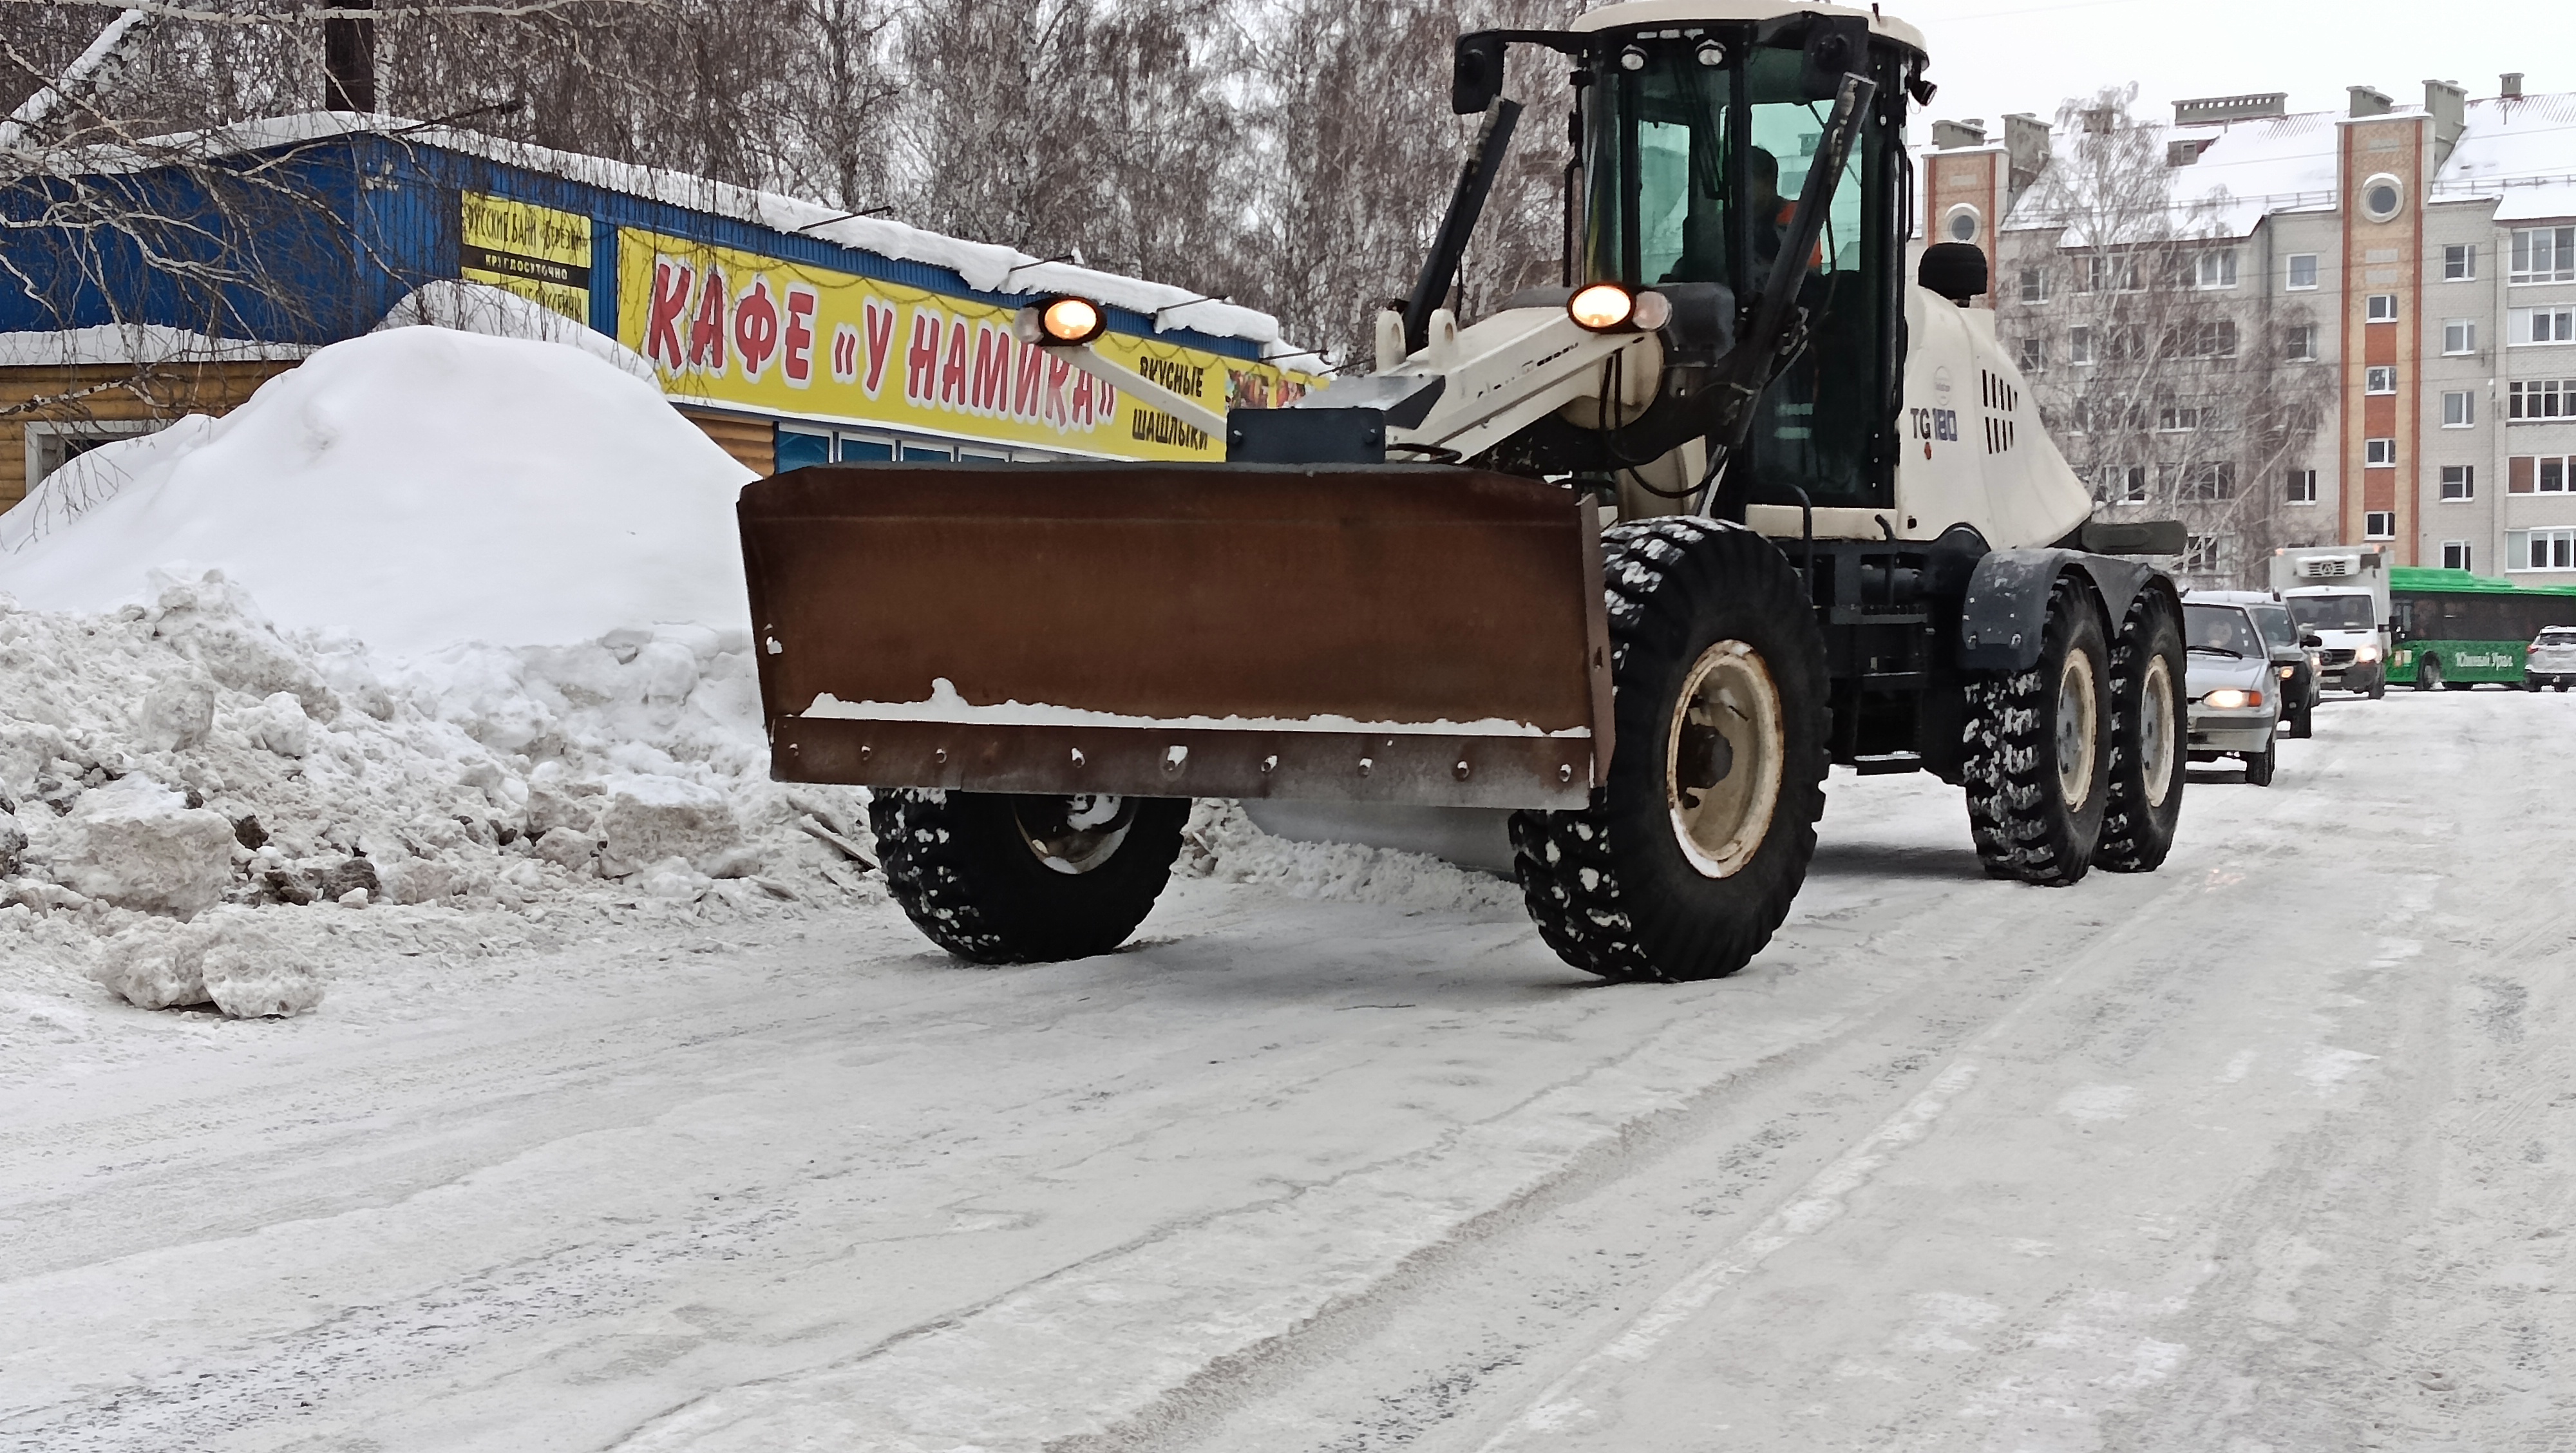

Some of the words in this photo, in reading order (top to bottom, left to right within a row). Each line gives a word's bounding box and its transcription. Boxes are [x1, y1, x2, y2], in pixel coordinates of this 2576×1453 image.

[512, 213, 536, 247] БАНИ
[486, 254, 568, 280] КРУГЛОСУТОЧНО
[647, 260, 815, 383] КАФЕ
[834, 303, 894, 392] «У
[908, 313, 1115, 428] НАМИКА»
[1140, 356, 1204, 397] ВКУСНЫЕ
[1132, 408, 1208, 451] ШАШЛЫКИ
